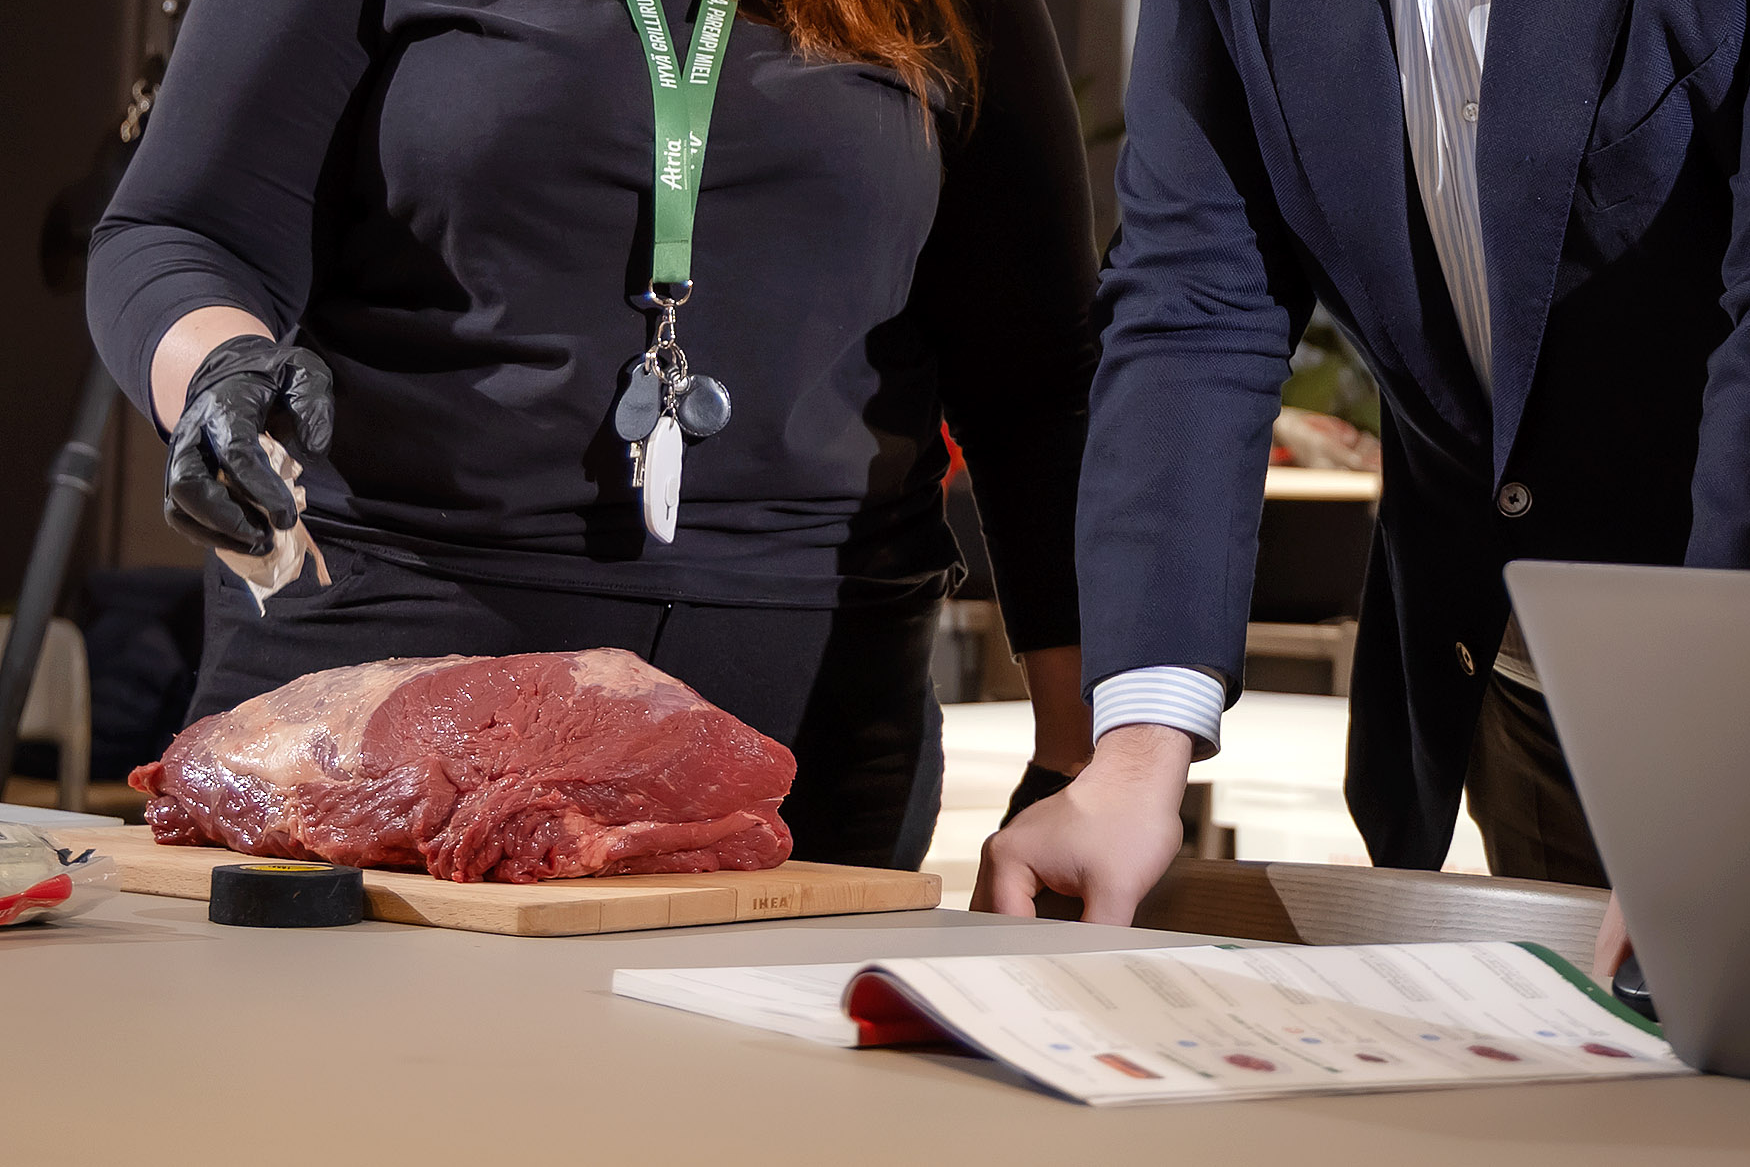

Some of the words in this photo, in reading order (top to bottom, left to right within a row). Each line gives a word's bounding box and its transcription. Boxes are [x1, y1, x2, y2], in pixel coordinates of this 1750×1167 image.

[697, 7, 726, 53] PAREMPI
[650, 53, 677, 89] HYVÄ
[689, 53, 714, 84] MIELI
[660, 137, 683, 190] Atria
[752, 896, 789, 910] IKEA
